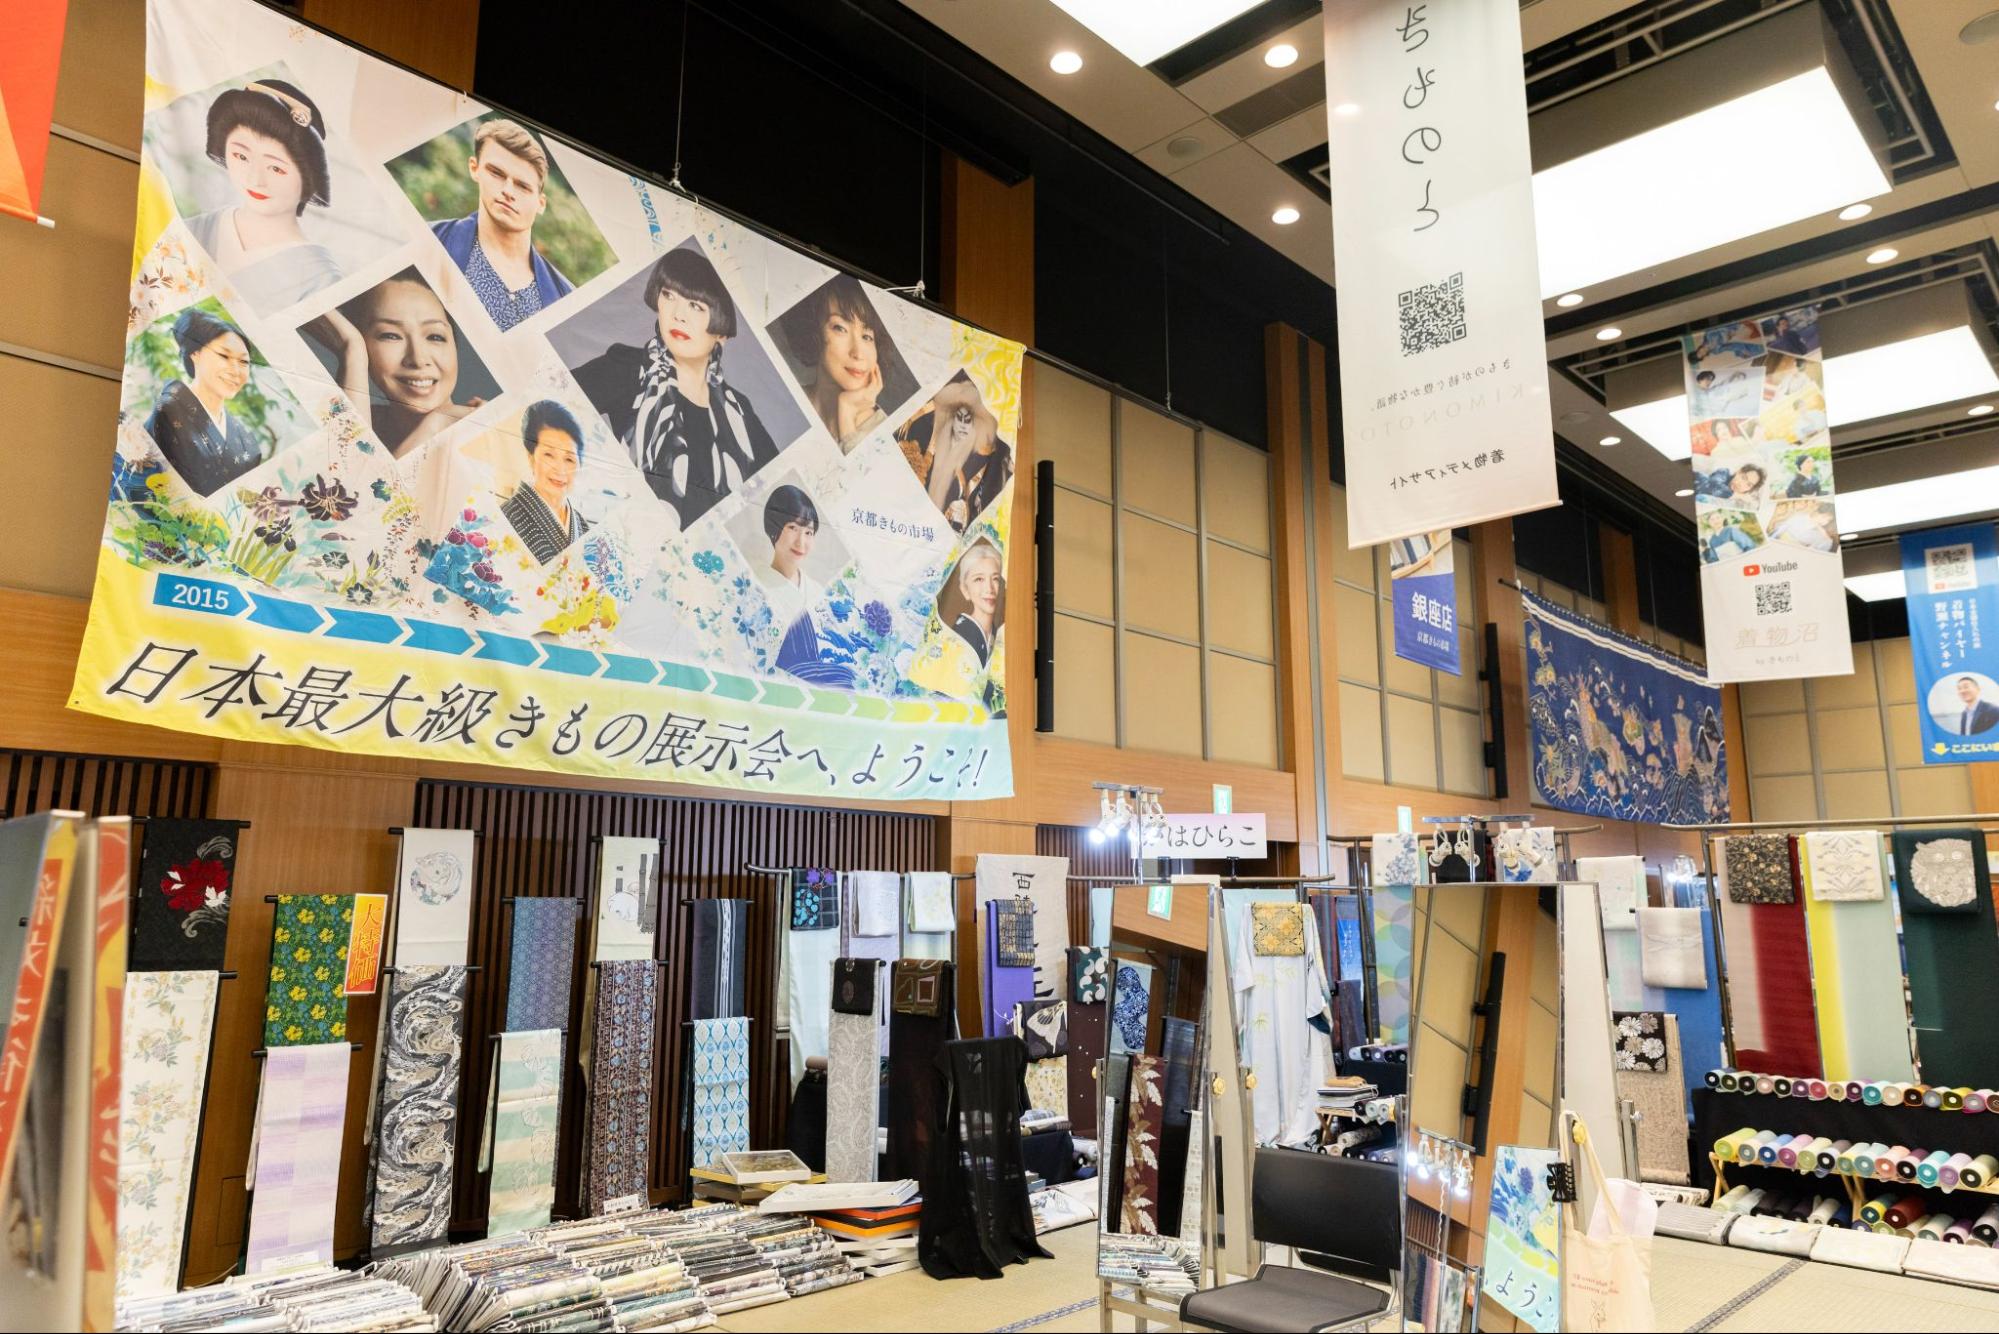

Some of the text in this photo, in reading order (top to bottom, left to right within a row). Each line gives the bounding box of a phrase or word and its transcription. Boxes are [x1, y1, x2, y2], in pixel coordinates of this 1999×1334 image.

[851, 507, 935, 542] 京都きもの市場
[1761, 560, 1798, 575] YouTube
[171, 583, 230, 611] 2015
[1411, 591, 1453, 633] 銀座店
